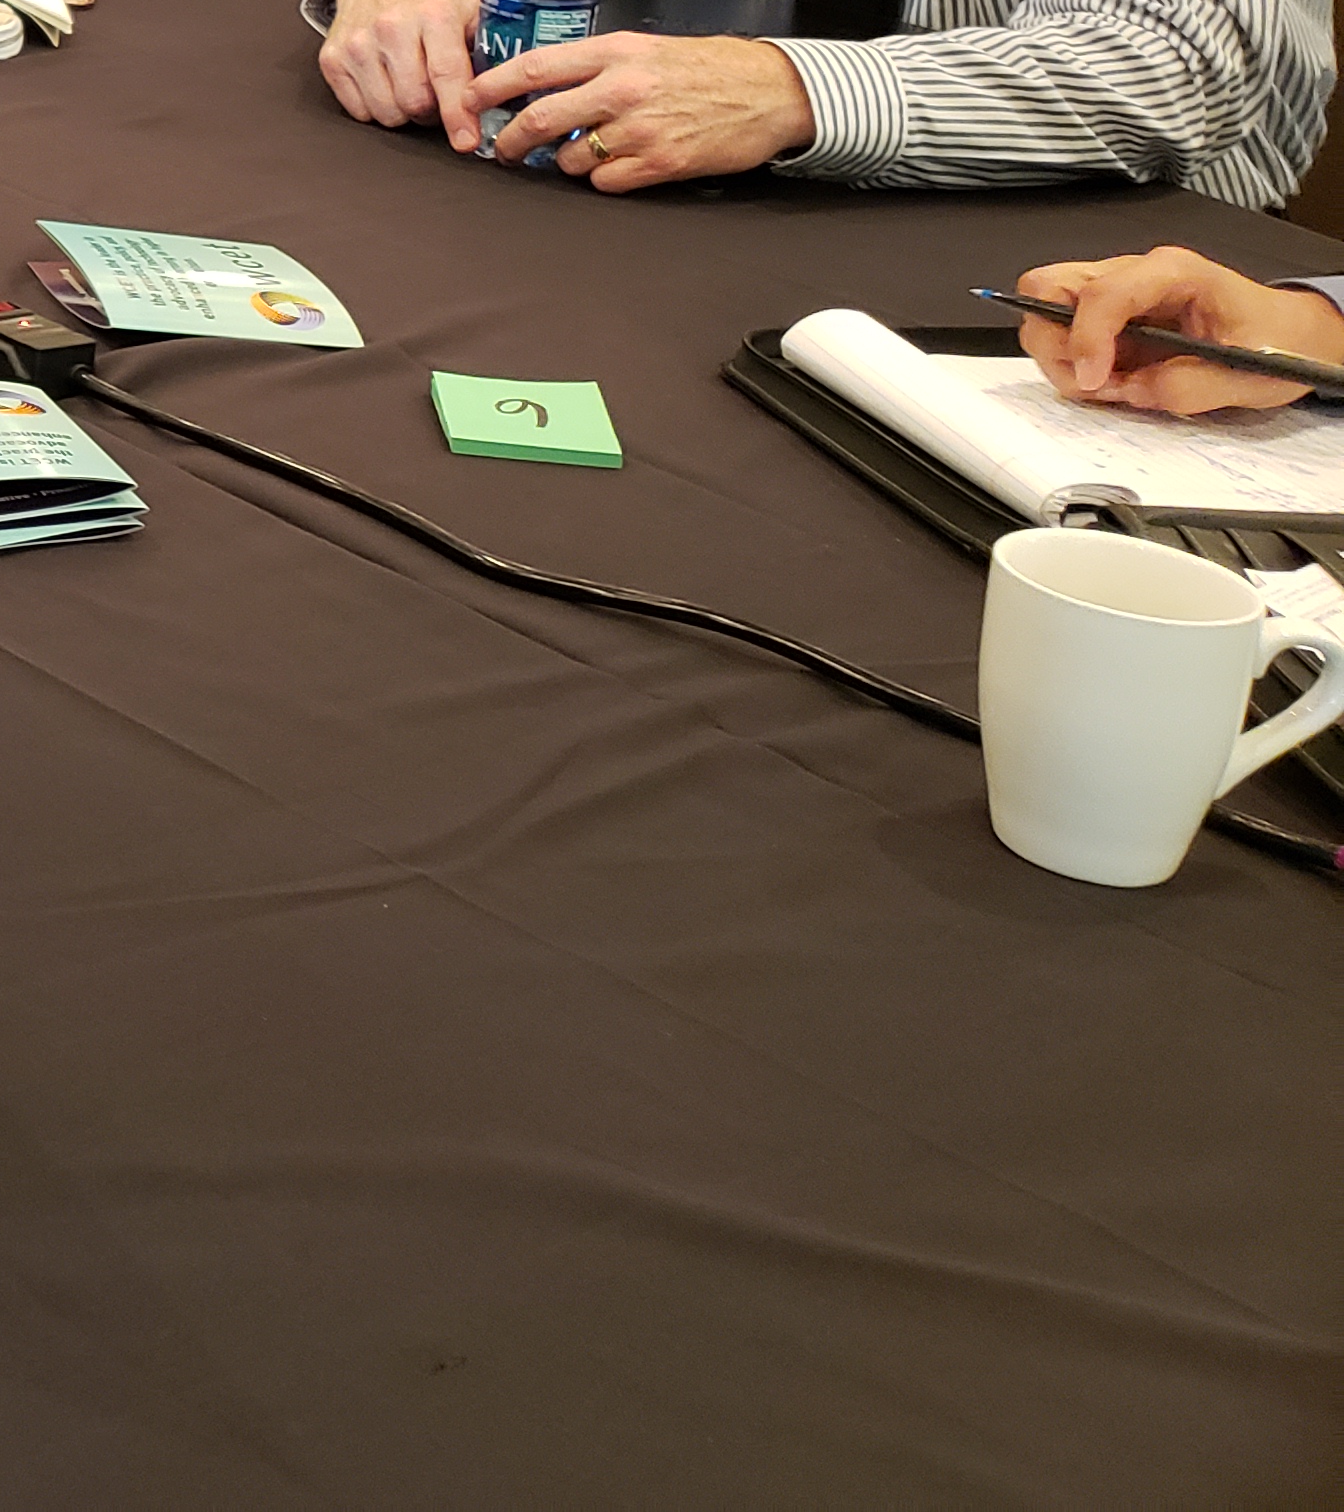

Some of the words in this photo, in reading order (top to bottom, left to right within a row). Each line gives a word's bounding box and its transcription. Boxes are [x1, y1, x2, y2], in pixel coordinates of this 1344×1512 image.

[201, 244, 282, 285] wcet
[150, 293, 167, 306] the
[160, 275, 190, 310] advocacy
